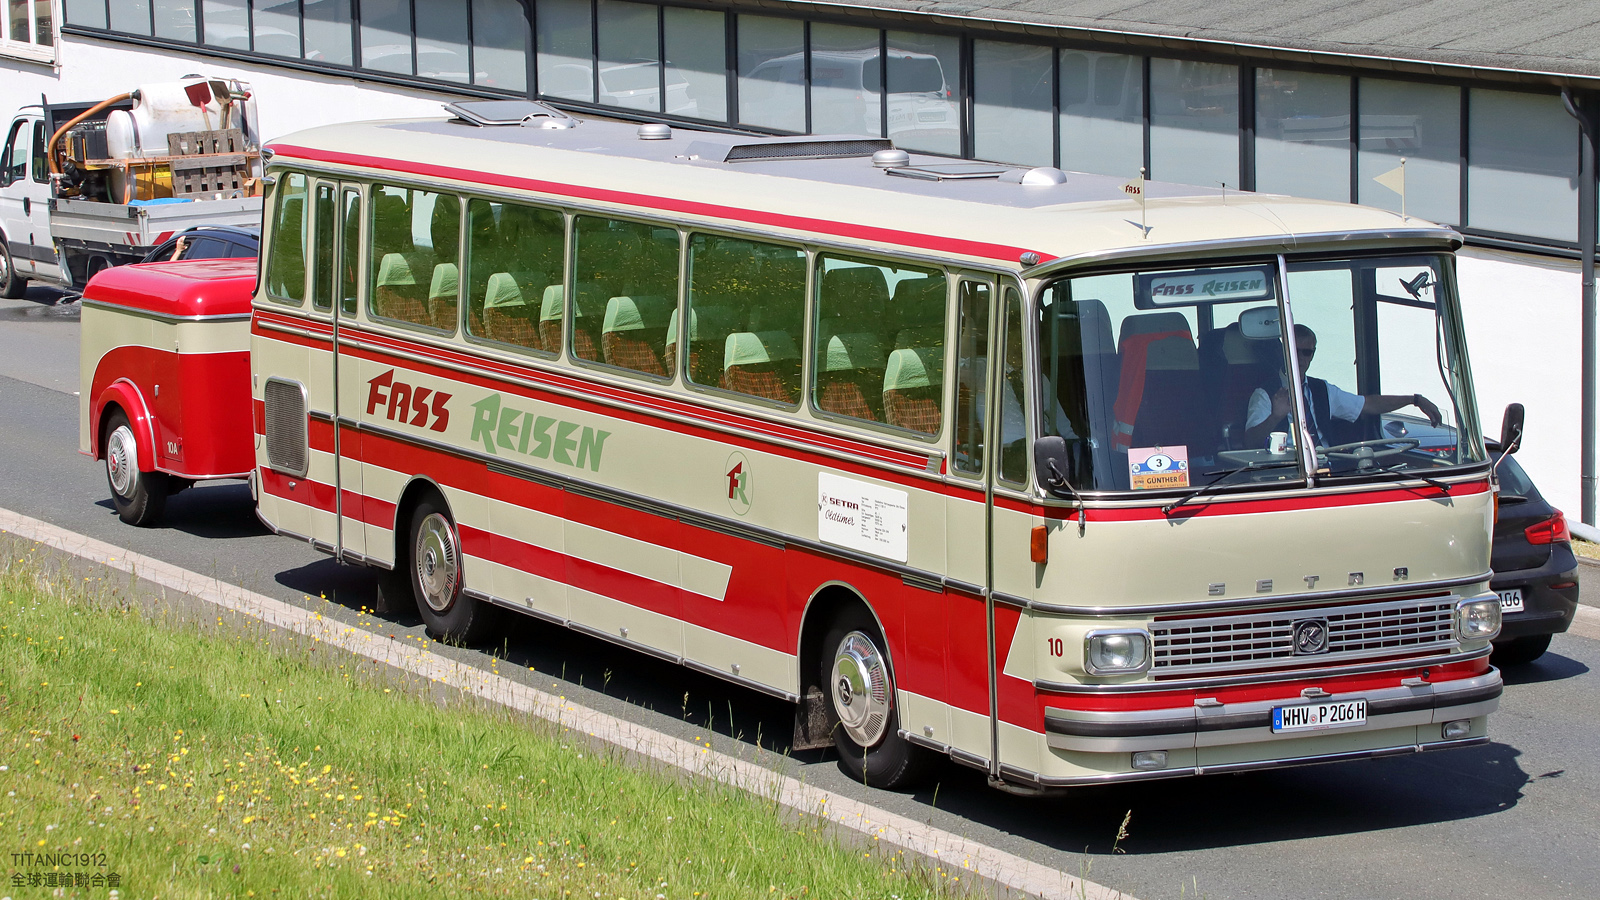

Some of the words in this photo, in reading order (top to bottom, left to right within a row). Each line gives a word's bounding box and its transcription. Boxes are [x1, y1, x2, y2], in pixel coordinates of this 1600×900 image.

[1125, 184, 1141, 195] FASS
[1152, 282, 1196, 297] FASS
[1201, 279, 1264, 297] REISEN
[366, 368, 453, 433] FASS
[469, 392, 612, 473] REISEN
[1155, 458, 1163, 468] 3
[1146, 475, 1178, 485] GÜNTHER
[829, 497, 859, 511] SETRA
[825, 509, 855, 527] Oldtimer
[1208, 566, 1409, 596] SETRA
[1047, 637, 1064, 658] 10
[1282, 706, 1310, 727] WHV
